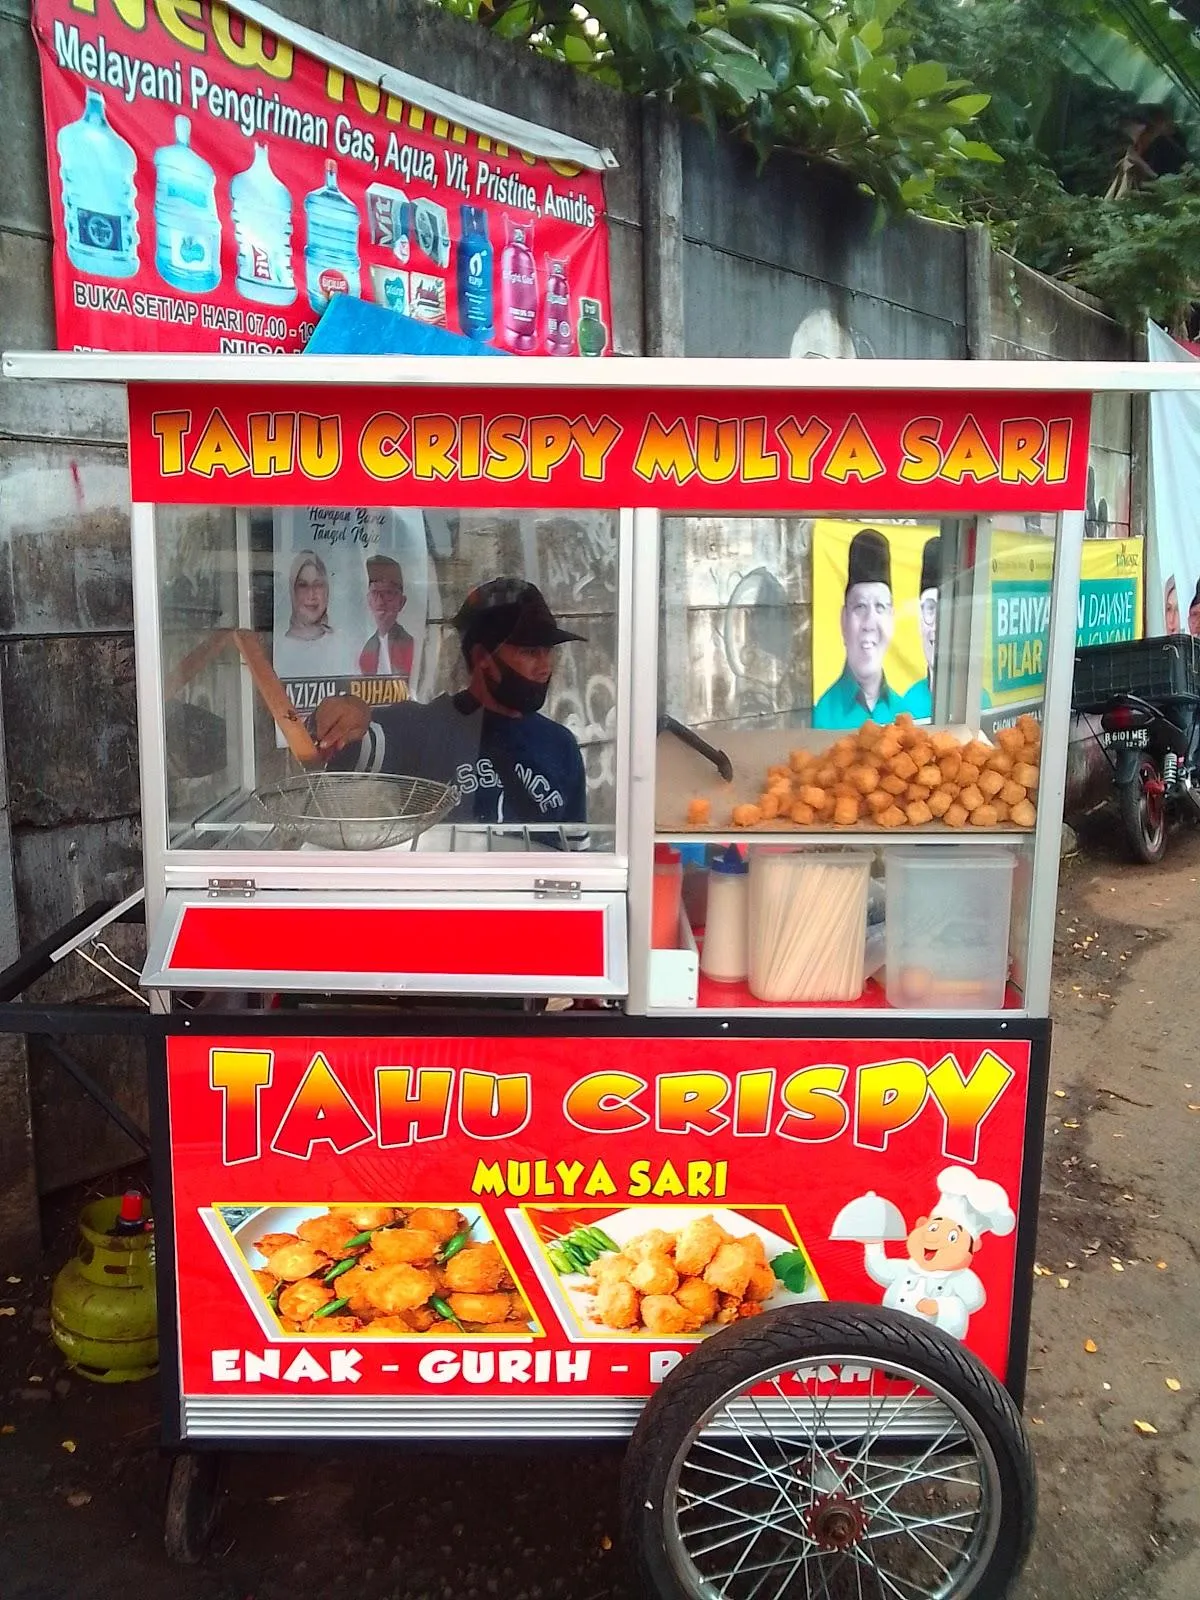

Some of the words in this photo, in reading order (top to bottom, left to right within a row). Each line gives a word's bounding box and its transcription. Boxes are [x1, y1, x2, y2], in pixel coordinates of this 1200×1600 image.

[54, 20, 183, 103] Melayani
[190, 66, 329, 148] Pengiriman
[335, 114, 380, 171] Gas,
[384, 131, 438, 189] Aqua,
[442, 149, 470, 199] Vit,
[475, 160, 543, 218] Pristine,
[544, 184, 596, 228] Amidis
[73, 281, 131, 313] BUKA
[133, 293, 198, 325] SETIAP
[201, 305, 244, 333] HARI
[246, 315, 287, 340] 07.00
[152, 408, 342, 480] TAHU
[358, 410, 624, 482] CRISPY
[632, 412, 887, 486] MULYA
[897, 412, 1074, 485] SARI
[998, 640, 1043, 681] PILAR
[209, 1047, 532, 1166] TAHU
[563, 1048, 1016, 1165] CRISPY
[471, 1158, 617, 1198] MULYA
[628, 1159, 729, 1198] SARI
[210, 1347, 364, 1384] ENAK
[418, 1348, 592, 1384] GURIH
